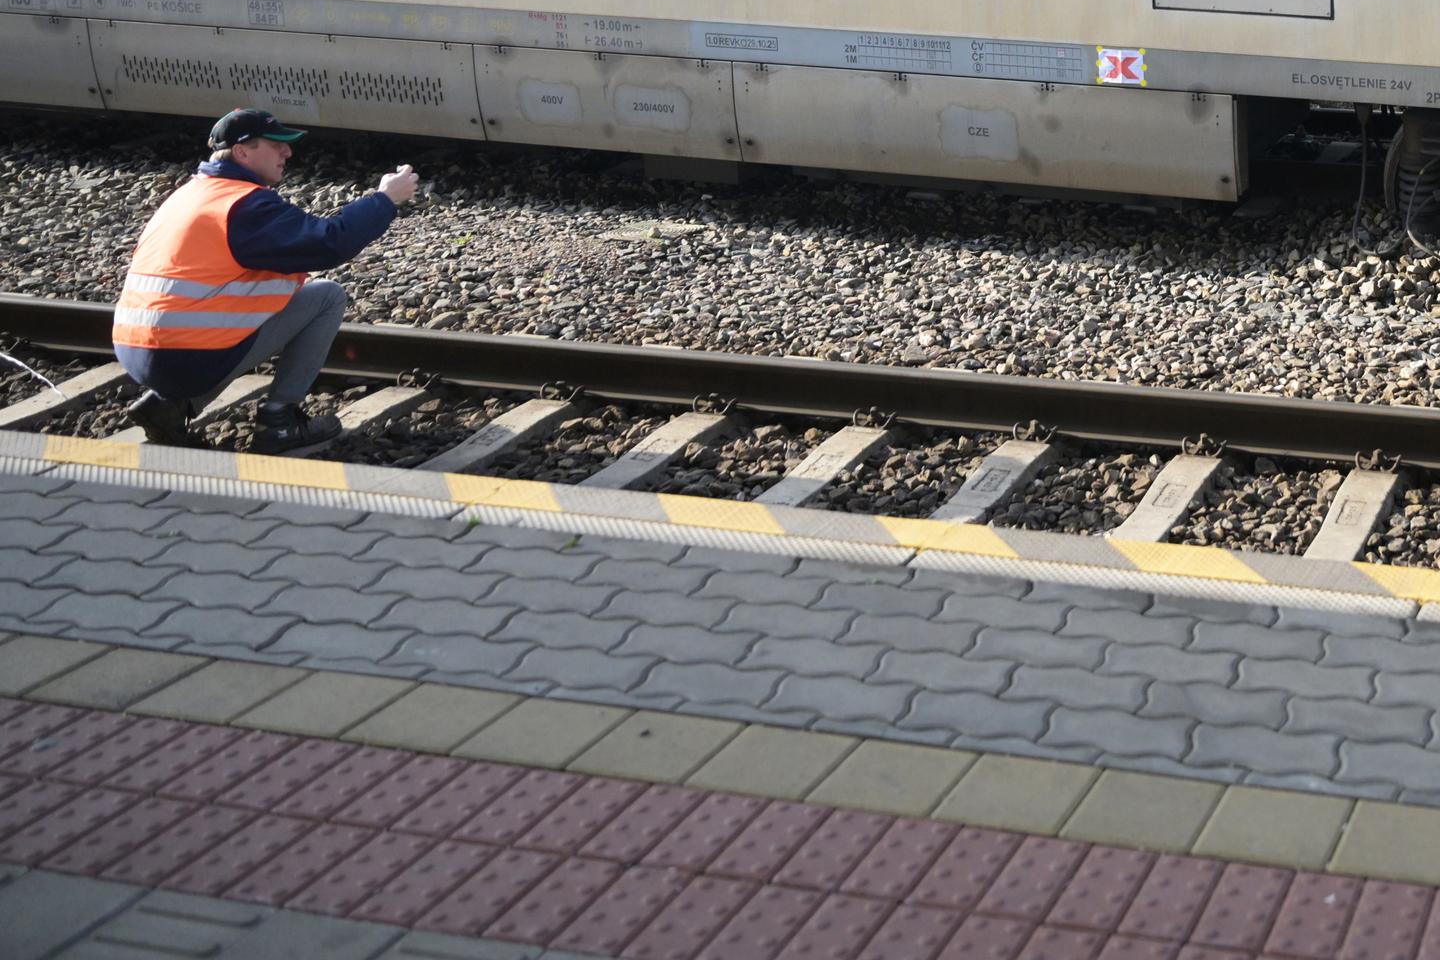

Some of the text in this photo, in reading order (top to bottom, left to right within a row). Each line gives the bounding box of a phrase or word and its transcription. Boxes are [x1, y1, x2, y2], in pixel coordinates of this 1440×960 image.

[161, 0, 202, 14] KOŠICE
[1292, 73, 1412, 91] EL.OSVETLENIE 24V
[541, 95, 564, 105] 400V
[632, 102, 675, 113] 230/400V
[968, 126, 989, 137] CZE
